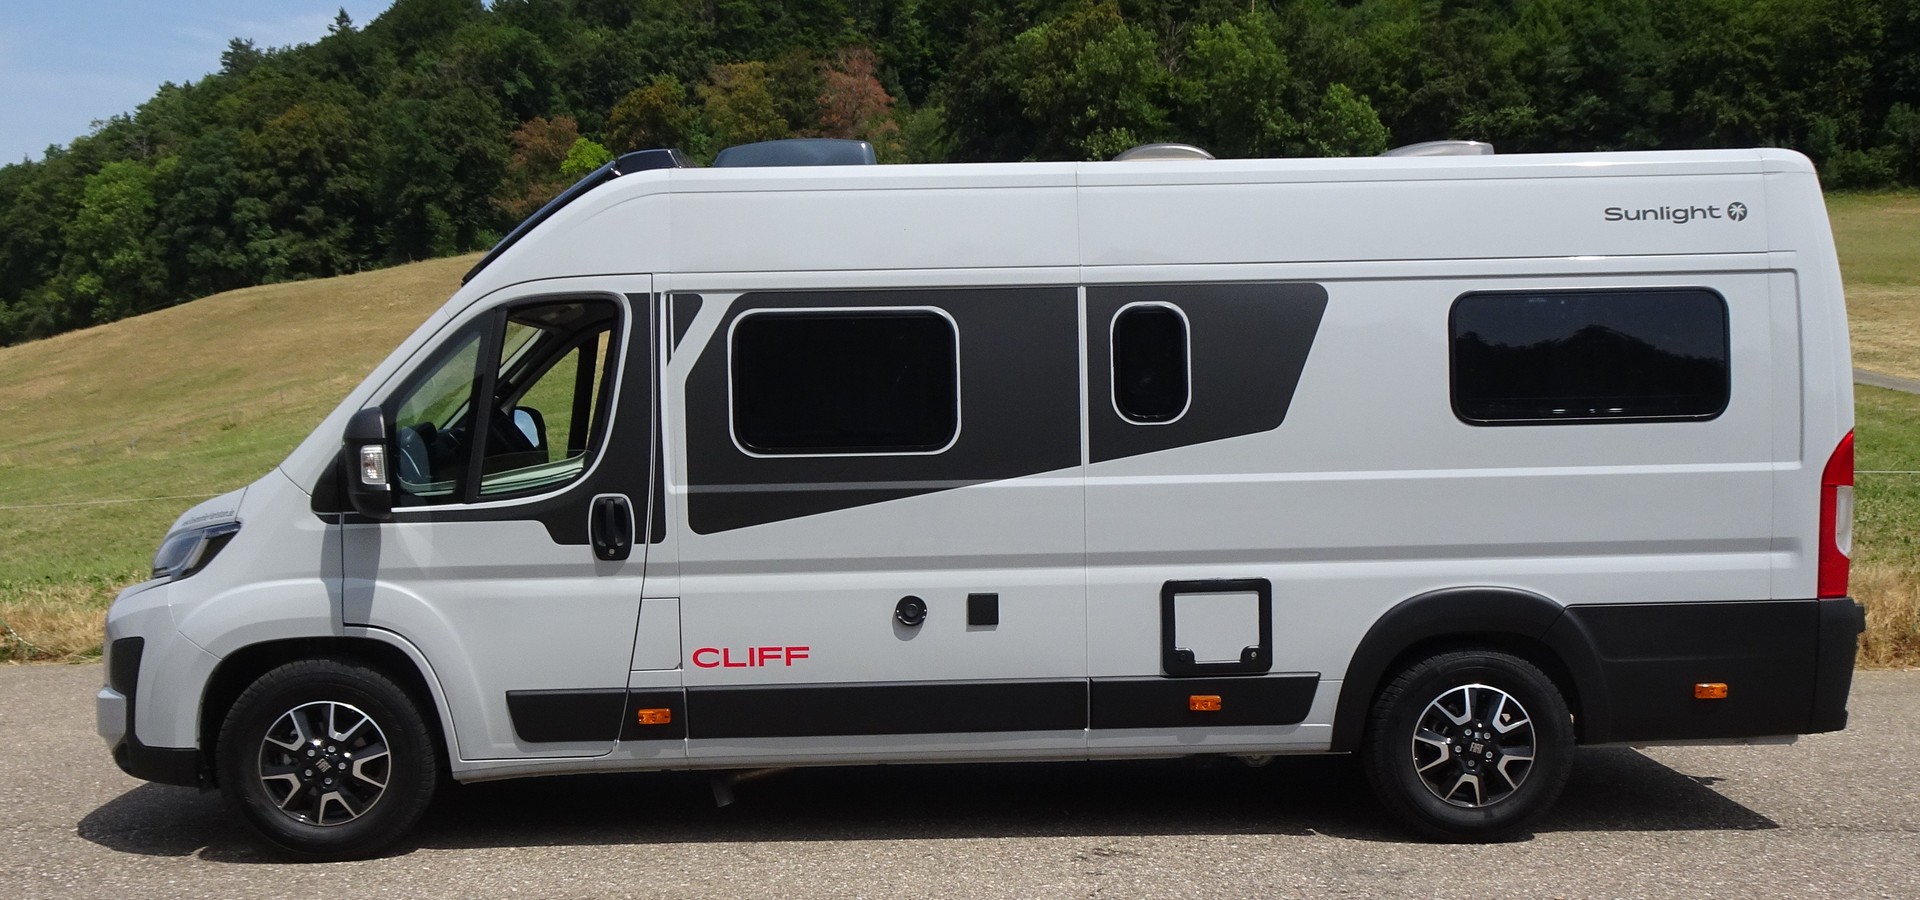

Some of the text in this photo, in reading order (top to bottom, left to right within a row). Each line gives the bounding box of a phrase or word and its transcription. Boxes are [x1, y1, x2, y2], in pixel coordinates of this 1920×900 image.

[1604, 205, 1722, 224] Sunlight
[692, 646, 810, 668] CLIFF
[1469, 742, 1484, 754] FIAT
